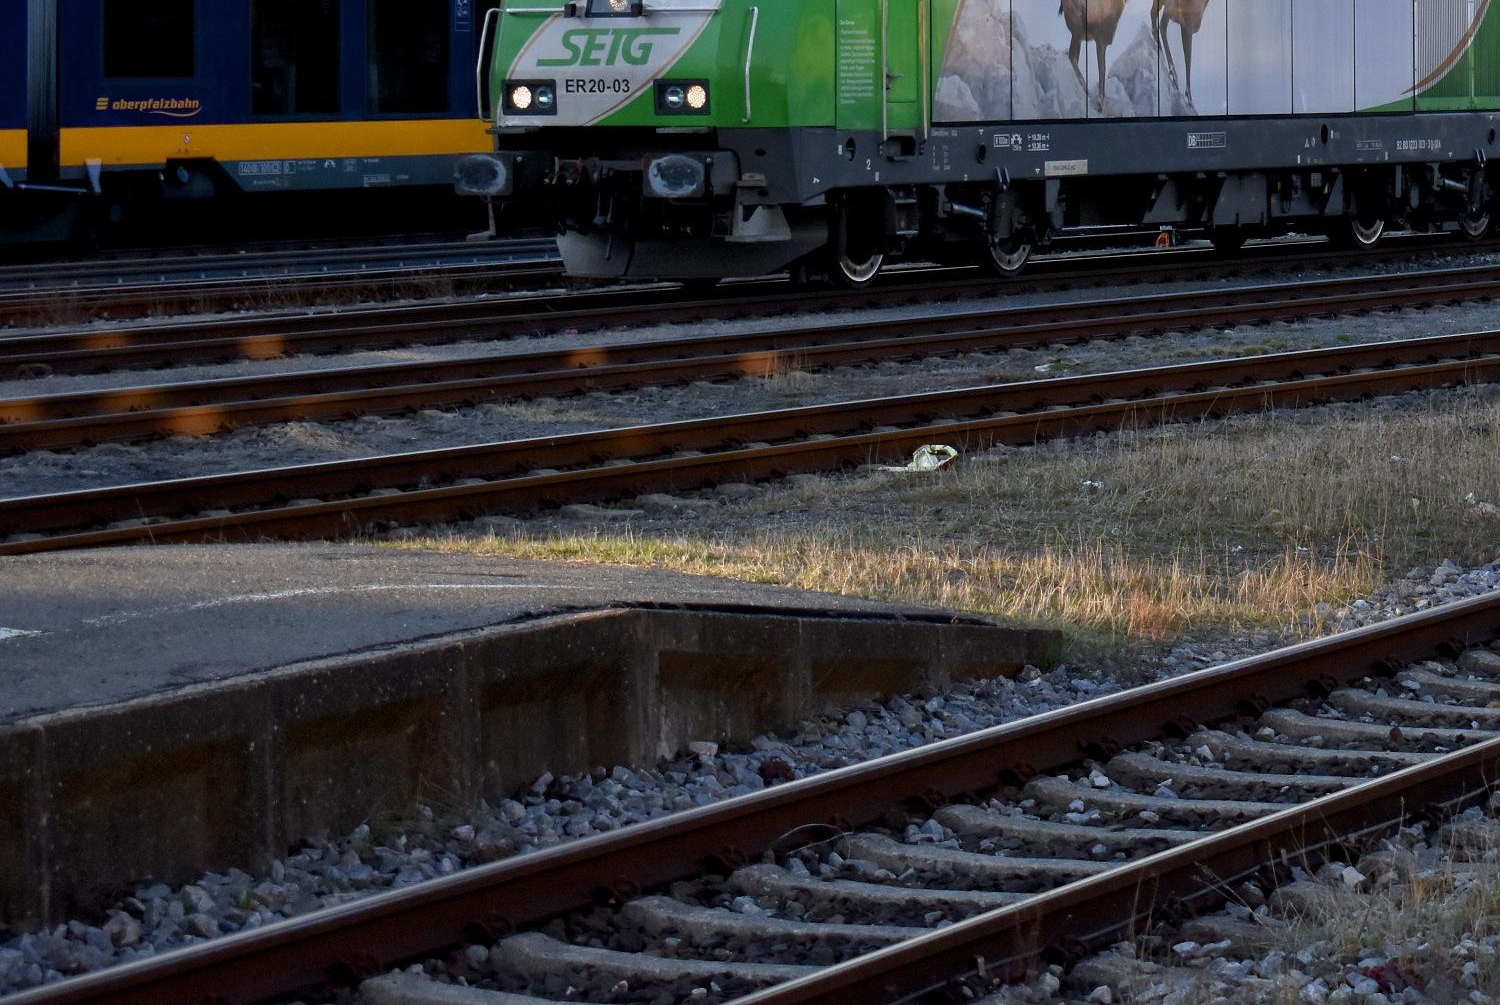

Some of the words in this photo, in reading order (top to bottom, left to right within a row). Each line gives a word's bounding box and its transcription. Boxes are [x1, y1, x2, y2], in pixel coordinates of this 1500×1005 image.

[536, 27, 681, 67] SETG
[112, 98, 200, 113] oberpfalzbahn
[866, 158, 871, 170] 2
